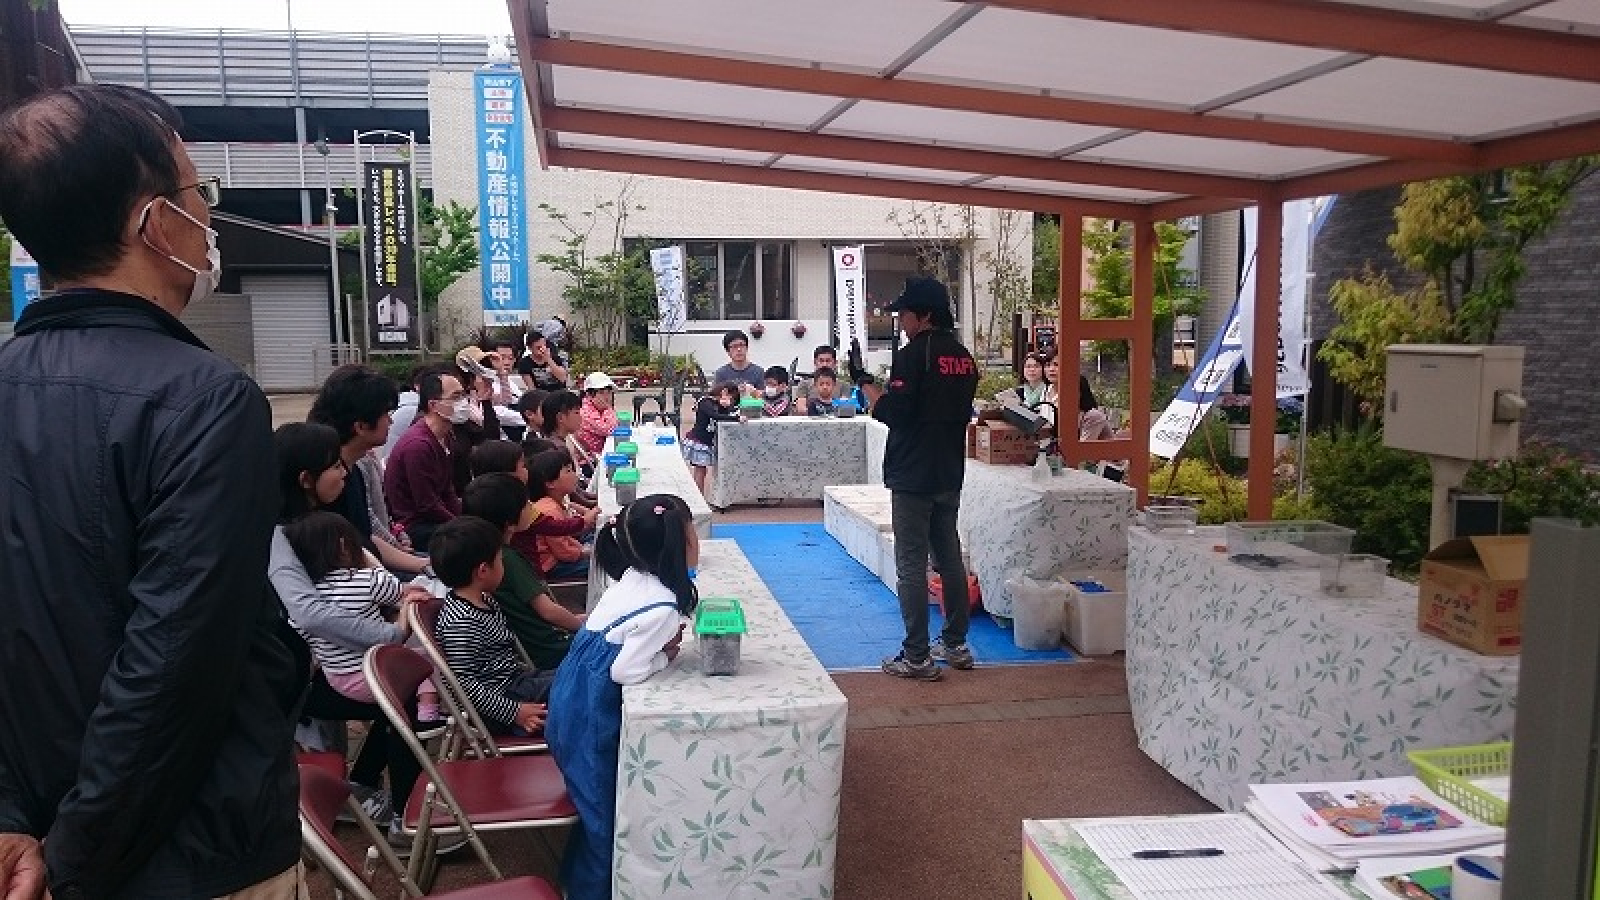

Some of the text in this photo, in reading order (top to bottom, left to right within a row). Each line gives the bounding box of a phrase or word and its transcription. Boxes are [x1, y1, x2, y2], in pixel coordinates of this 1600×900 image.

[485, 127, 511, 305] 不動産情報公開中
